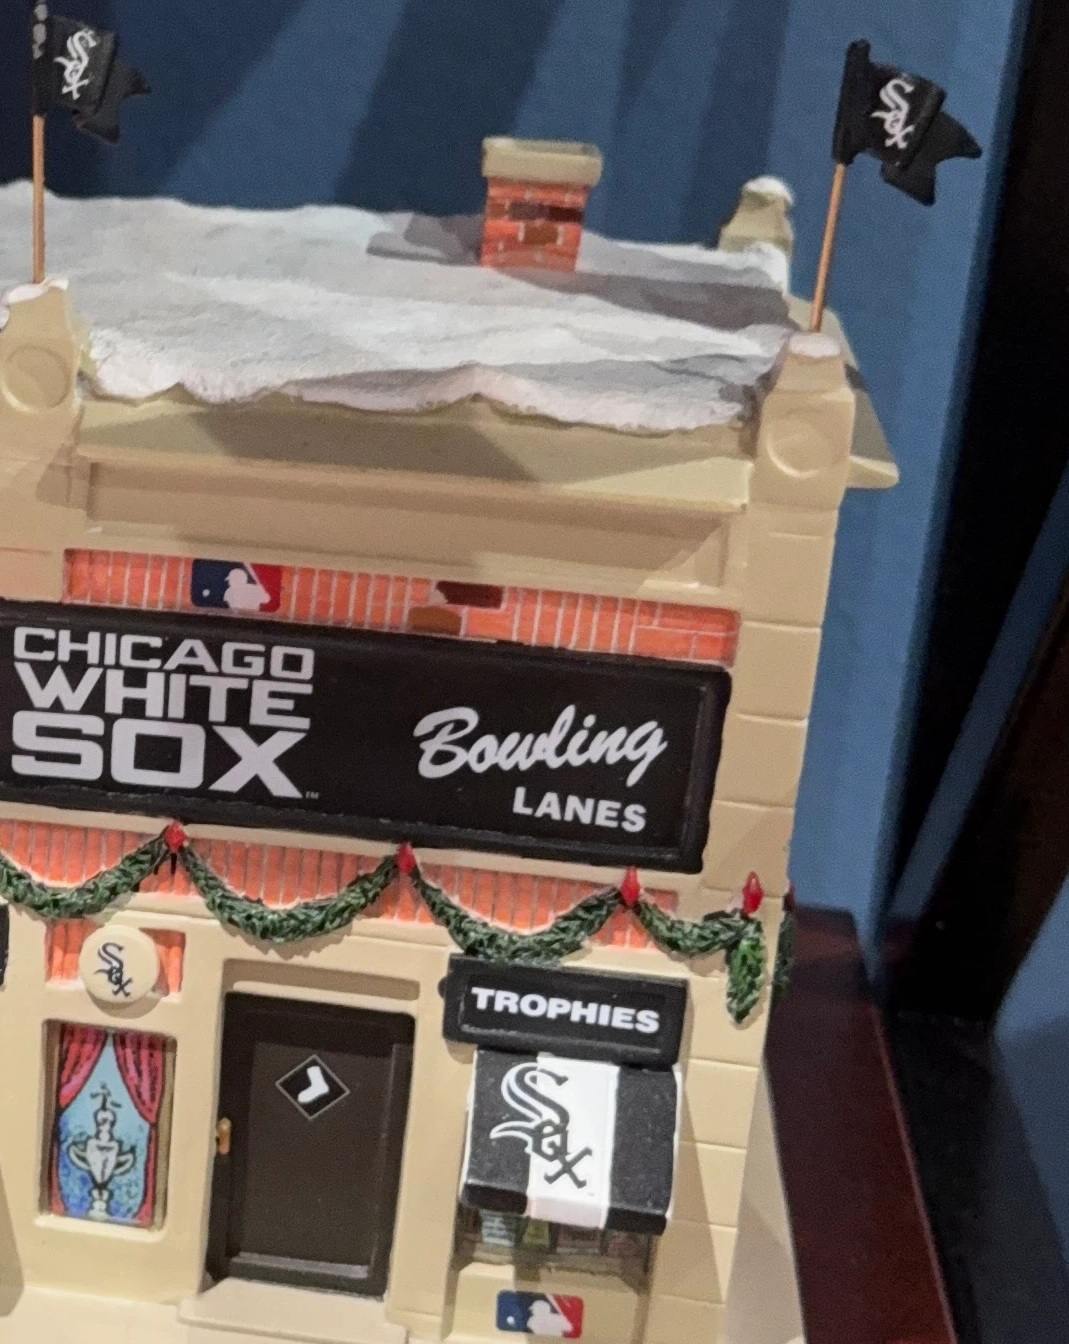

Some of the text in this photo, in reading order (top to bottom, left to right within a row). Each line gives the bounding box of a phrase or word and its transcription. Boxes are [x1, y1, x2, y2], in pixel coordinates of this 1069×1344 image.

[13, 626, 315, 681] CHICAGO
[14, 661, 314, 729] WHITE
[11, 710, 307, 799] SOX
[413, 705, 667, 787] Bowling
[512, 786, 647, 833] LANES
[471, 986, 660, 1034] TROPHIES
